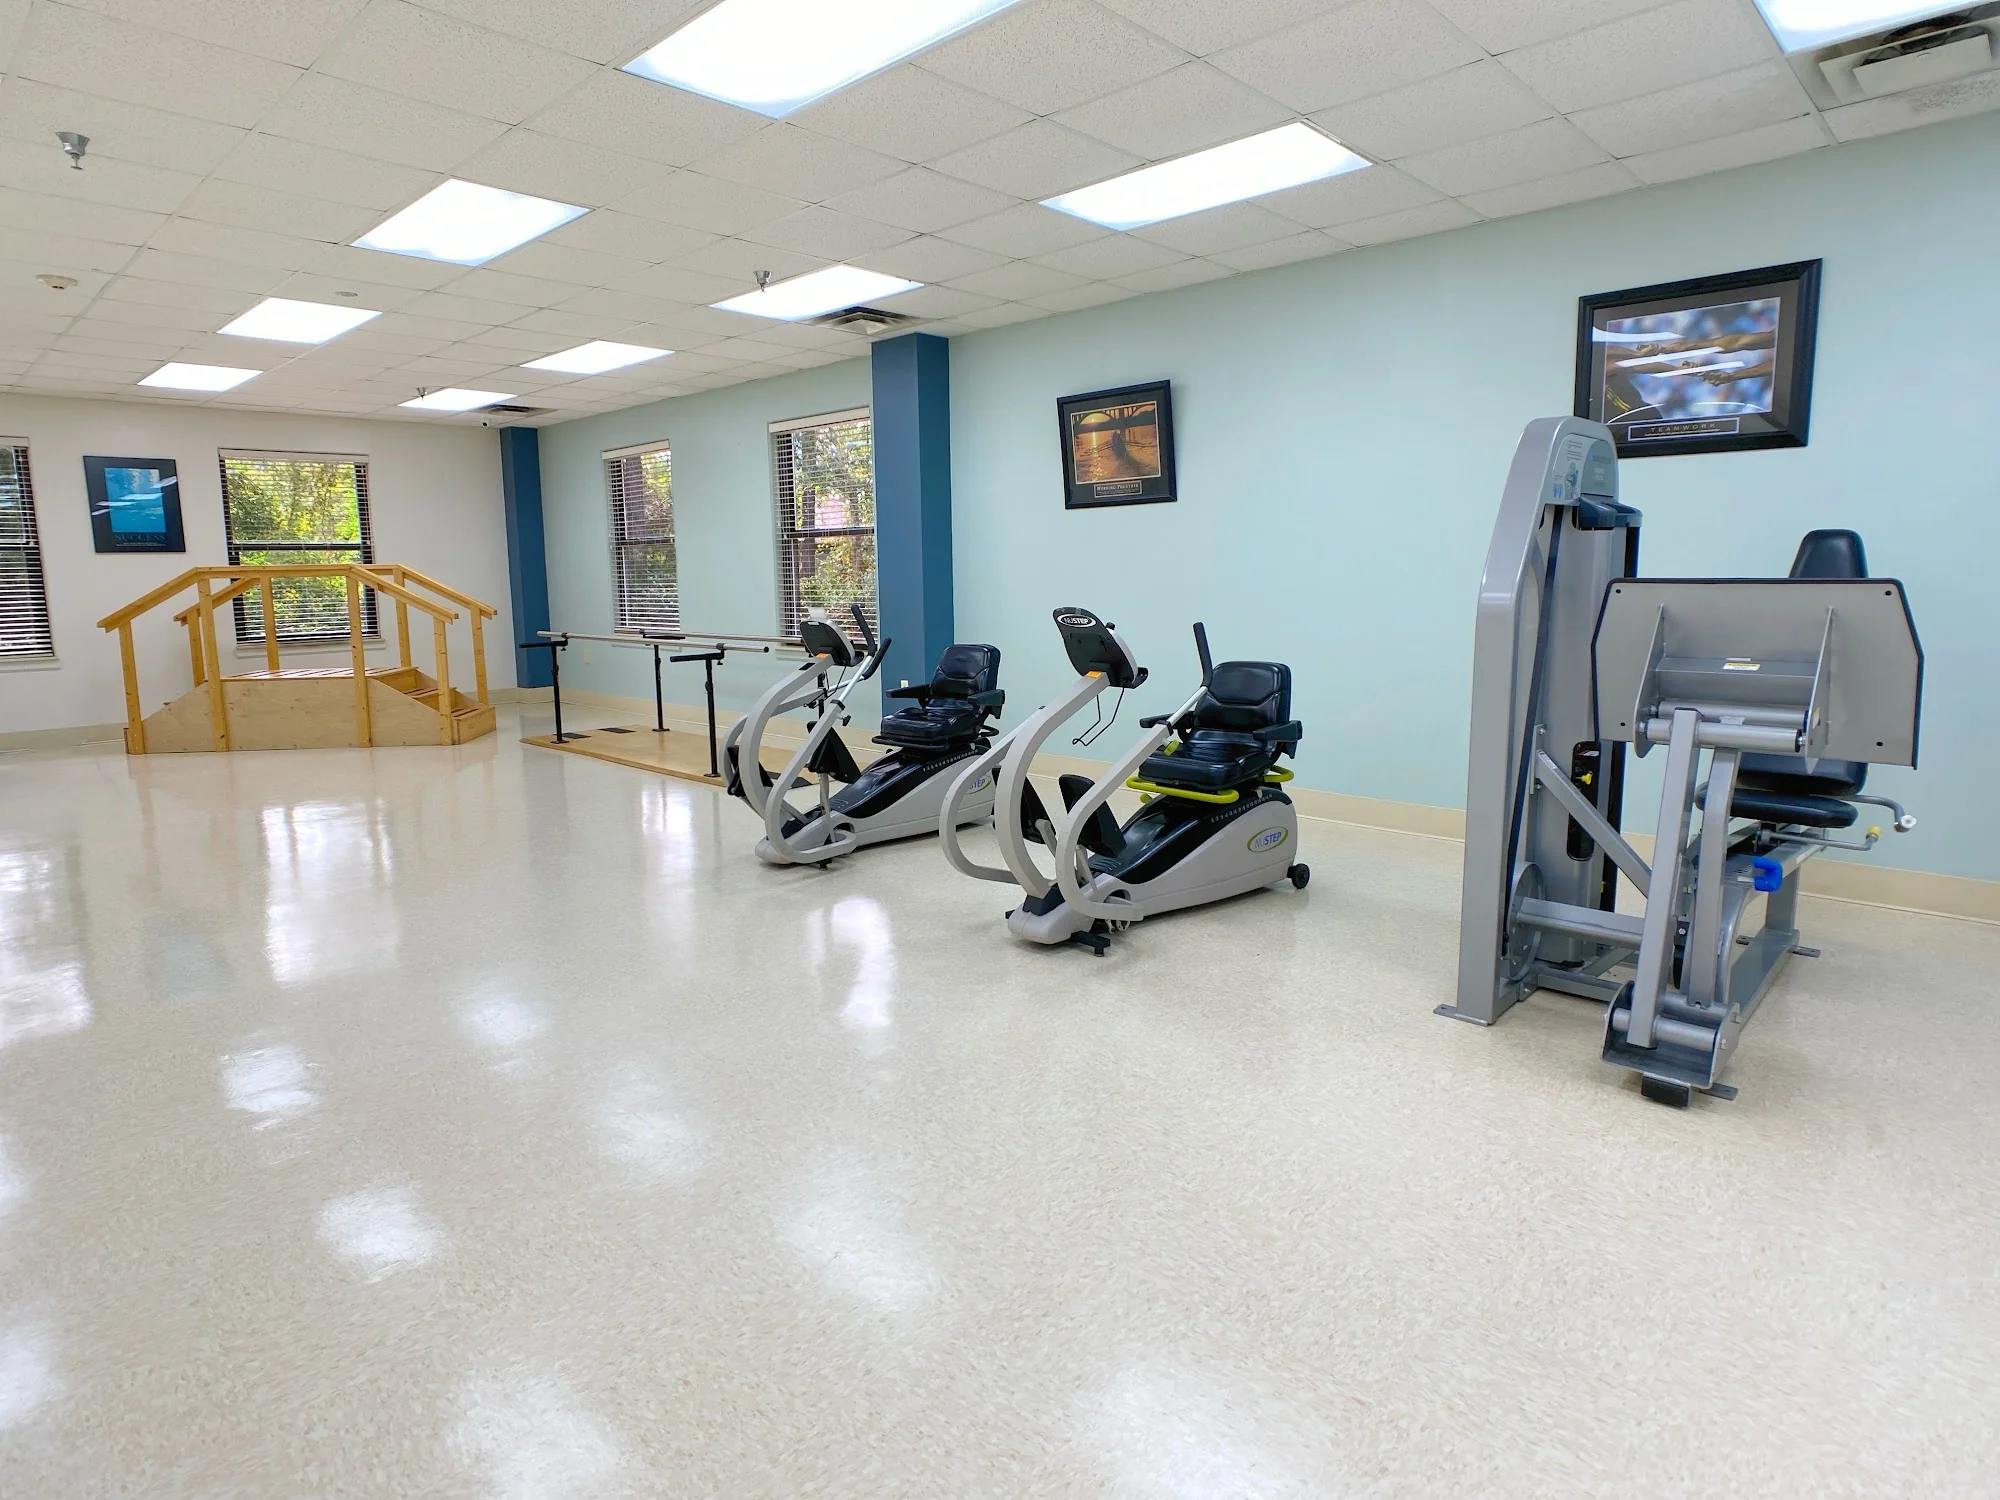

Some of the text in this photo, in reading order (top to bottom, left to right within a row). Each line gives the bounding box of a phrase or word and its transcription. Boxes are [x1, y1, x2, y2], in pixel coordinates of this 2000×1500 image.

[1650, 423, 1716, 433] TEAMWORK
[114, 533, 166, 541] SUCCESS
[1254, 831, 1282, 849] NUSTEP
